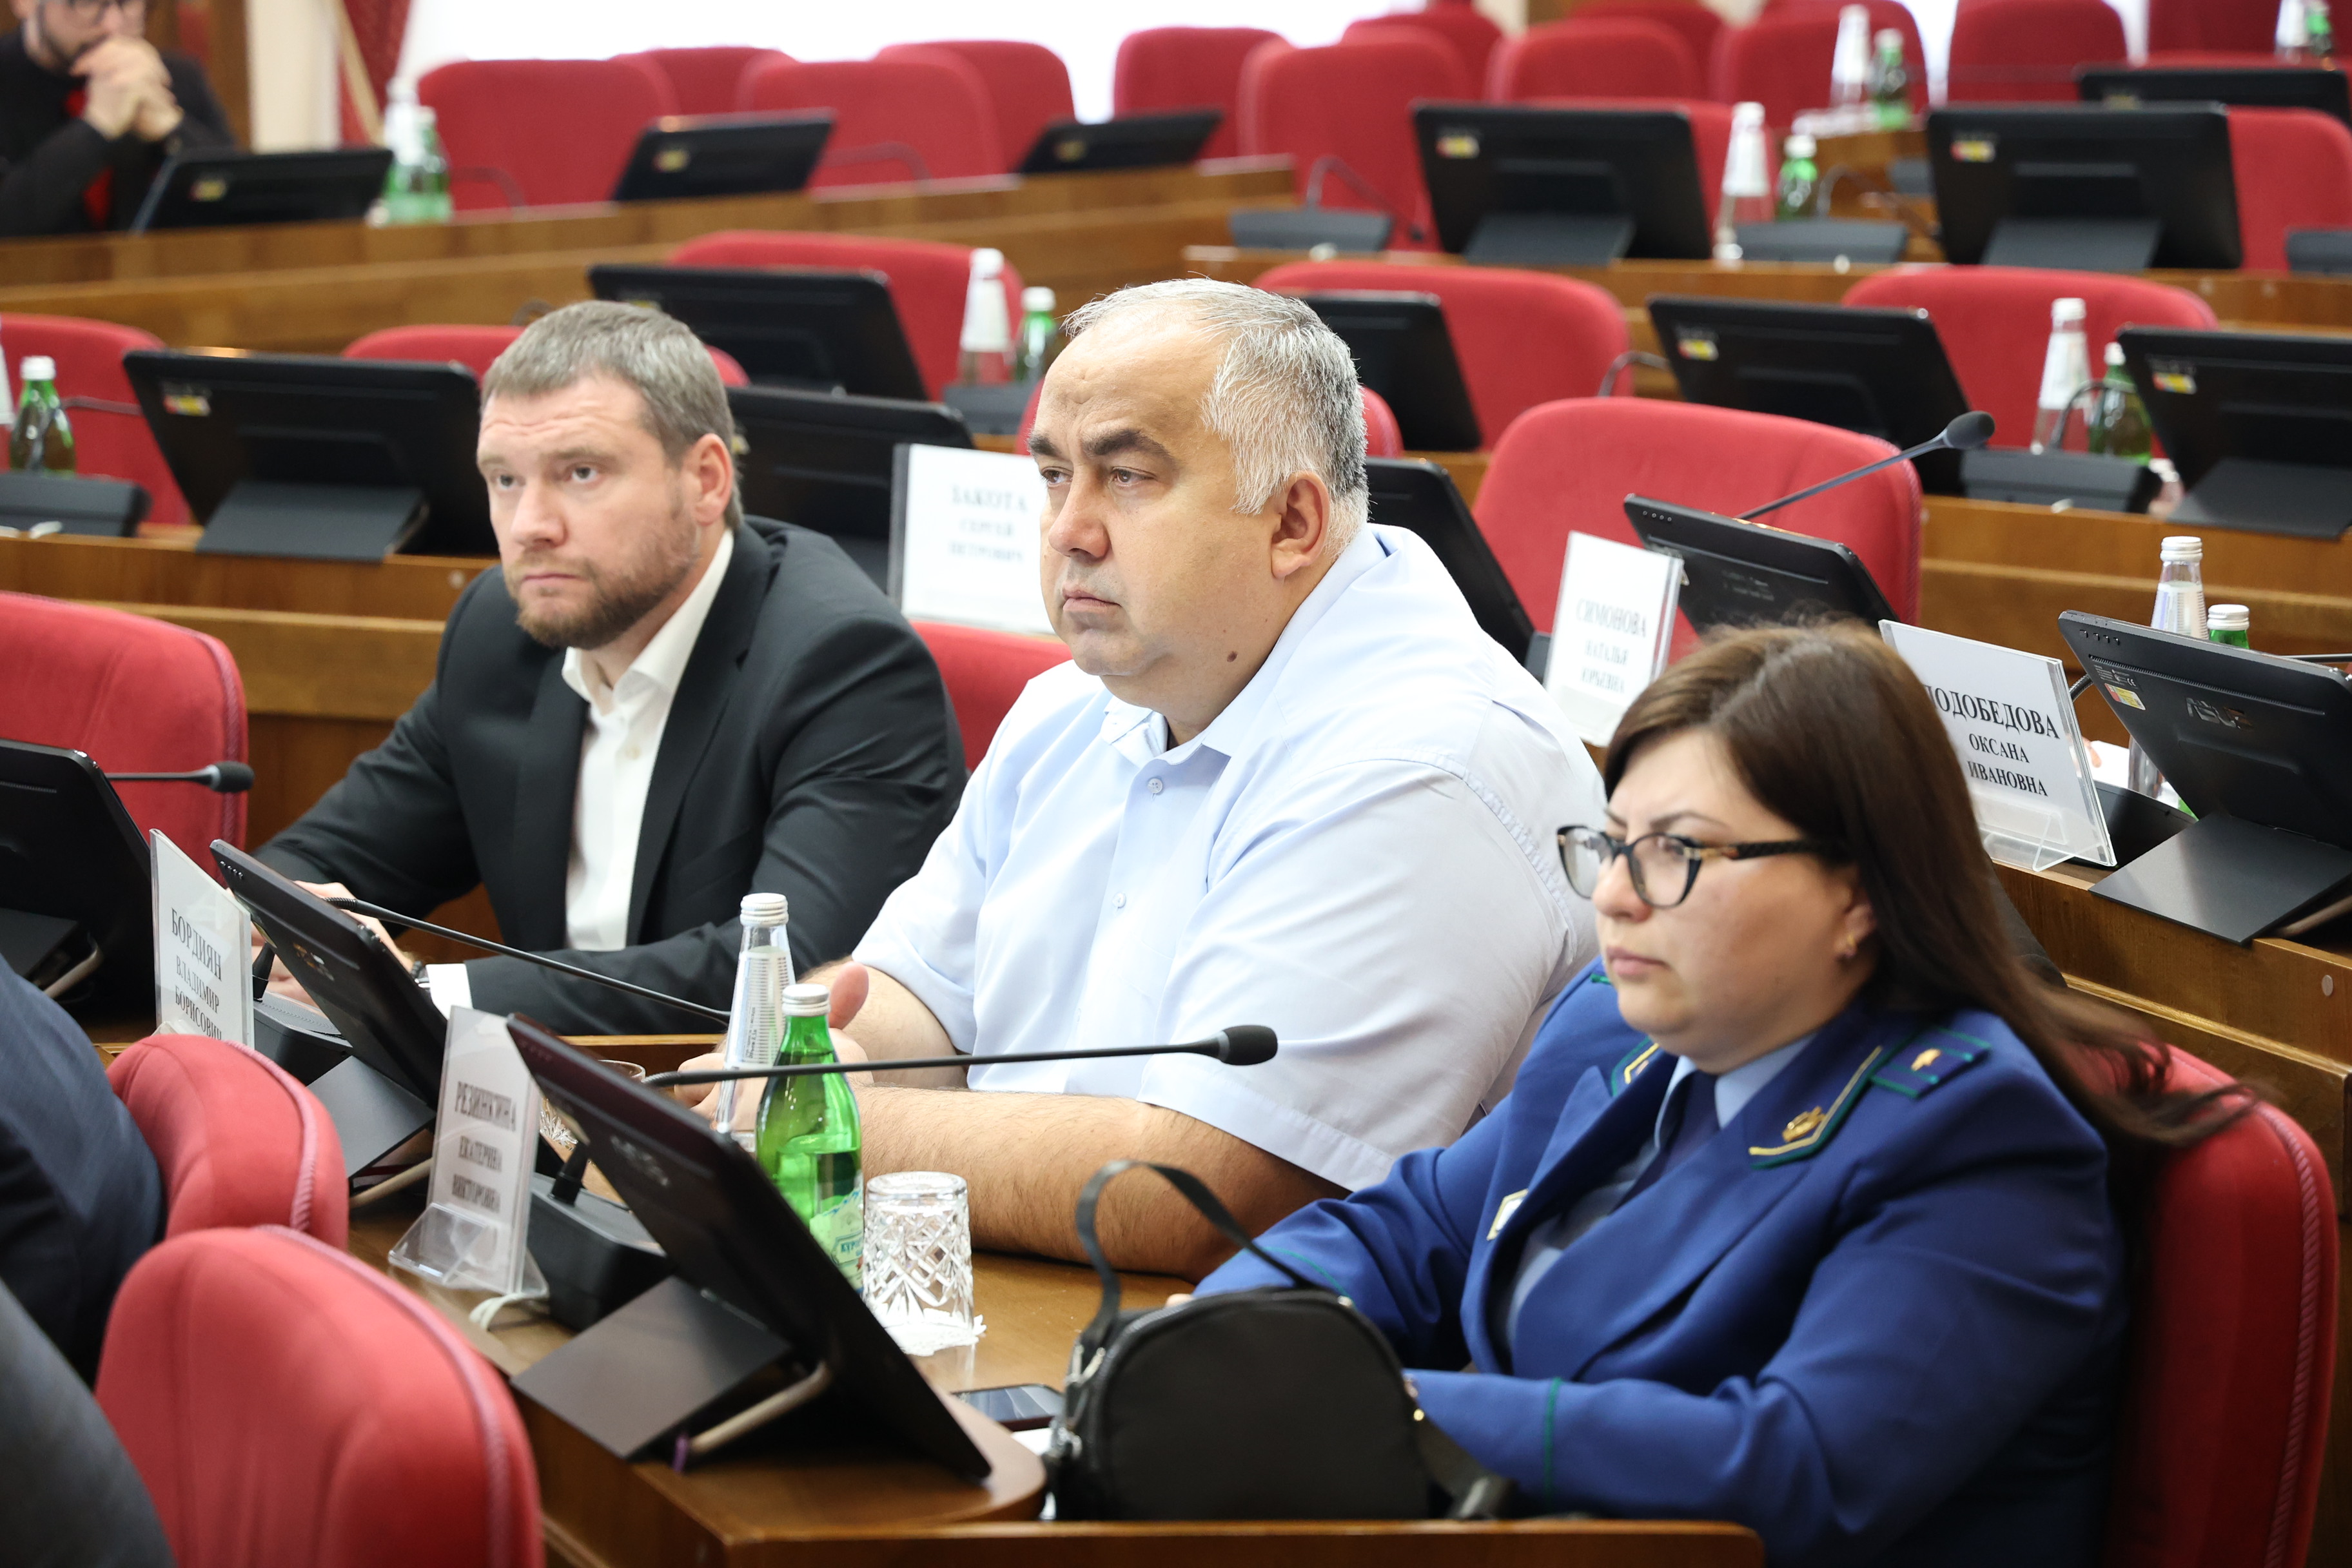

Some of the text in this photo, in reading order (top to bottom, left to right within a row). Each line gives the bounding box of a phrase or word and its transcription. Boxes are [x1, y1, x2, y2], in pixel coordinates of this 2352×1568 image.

[1576, 598, 1647, 638] СИМОНОВА
[1969, 733, 2030, 763] ОКСАНА
[1967, 761, 2048, 797] ИВАНОВНА
[172, 907, 222, 981] БОРДИЯН
[176, 955, 219, 1014] ВЛАДИМИР
